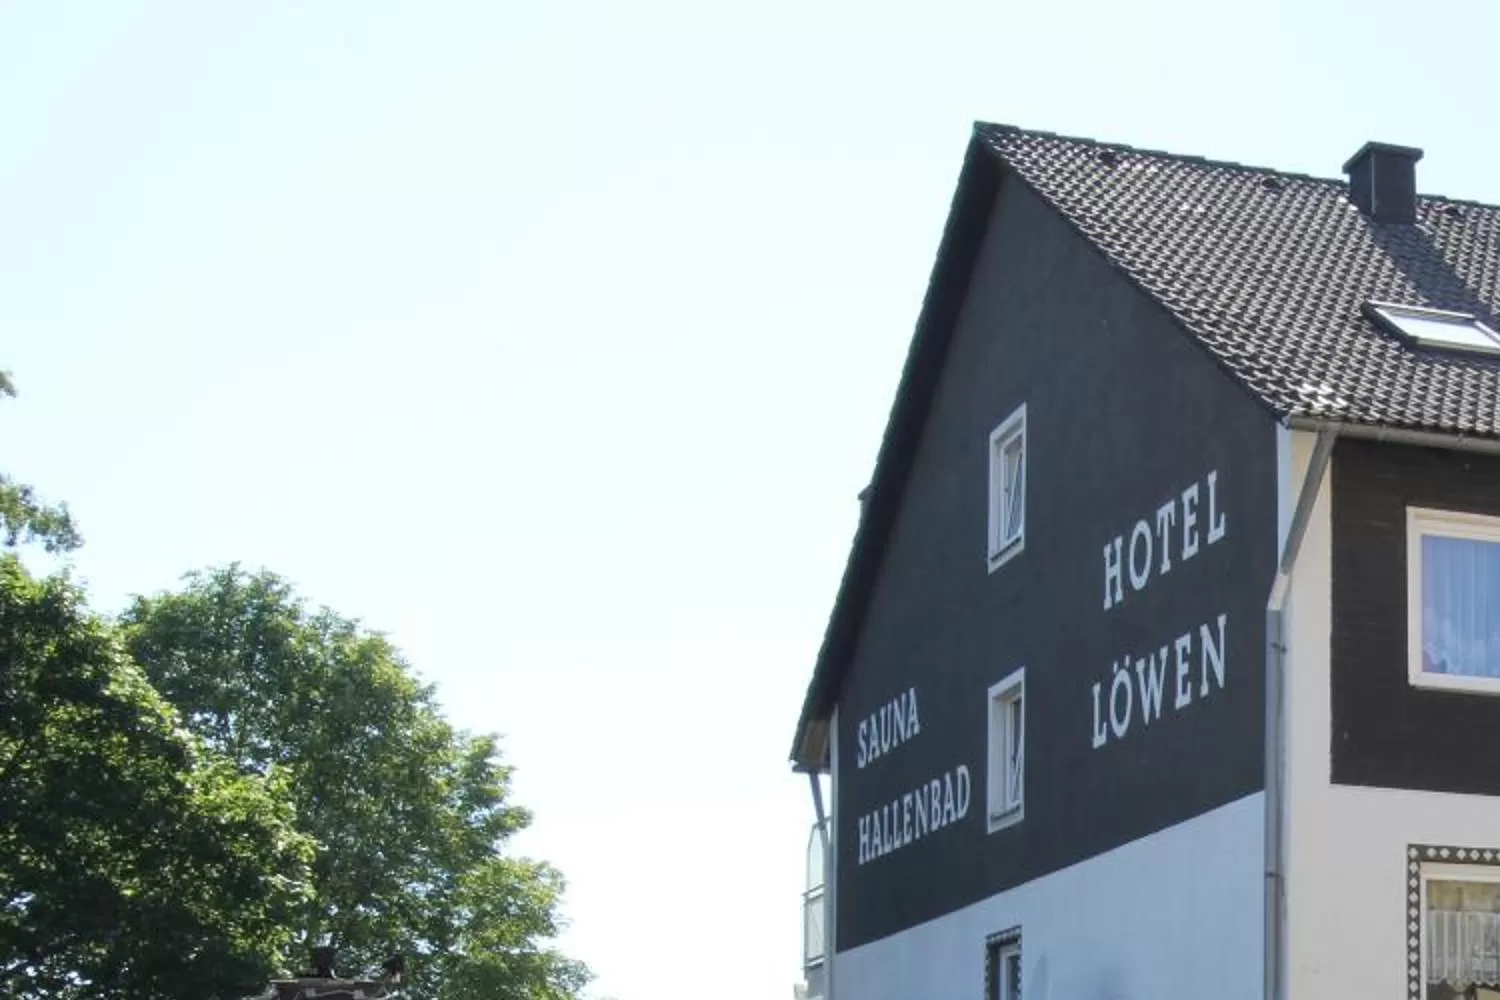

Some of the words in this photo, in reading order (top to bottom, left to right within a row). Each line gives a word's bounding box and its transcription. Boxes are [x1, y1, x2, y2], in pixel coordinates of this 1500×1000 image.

[1103, 470, 1225, 610] HOTEL
[857, 688, 920, 768] SAUNA
[1092, 614, 1227, 748] LÖWEN
[858, 764, 971, 865] HALLENBAD
